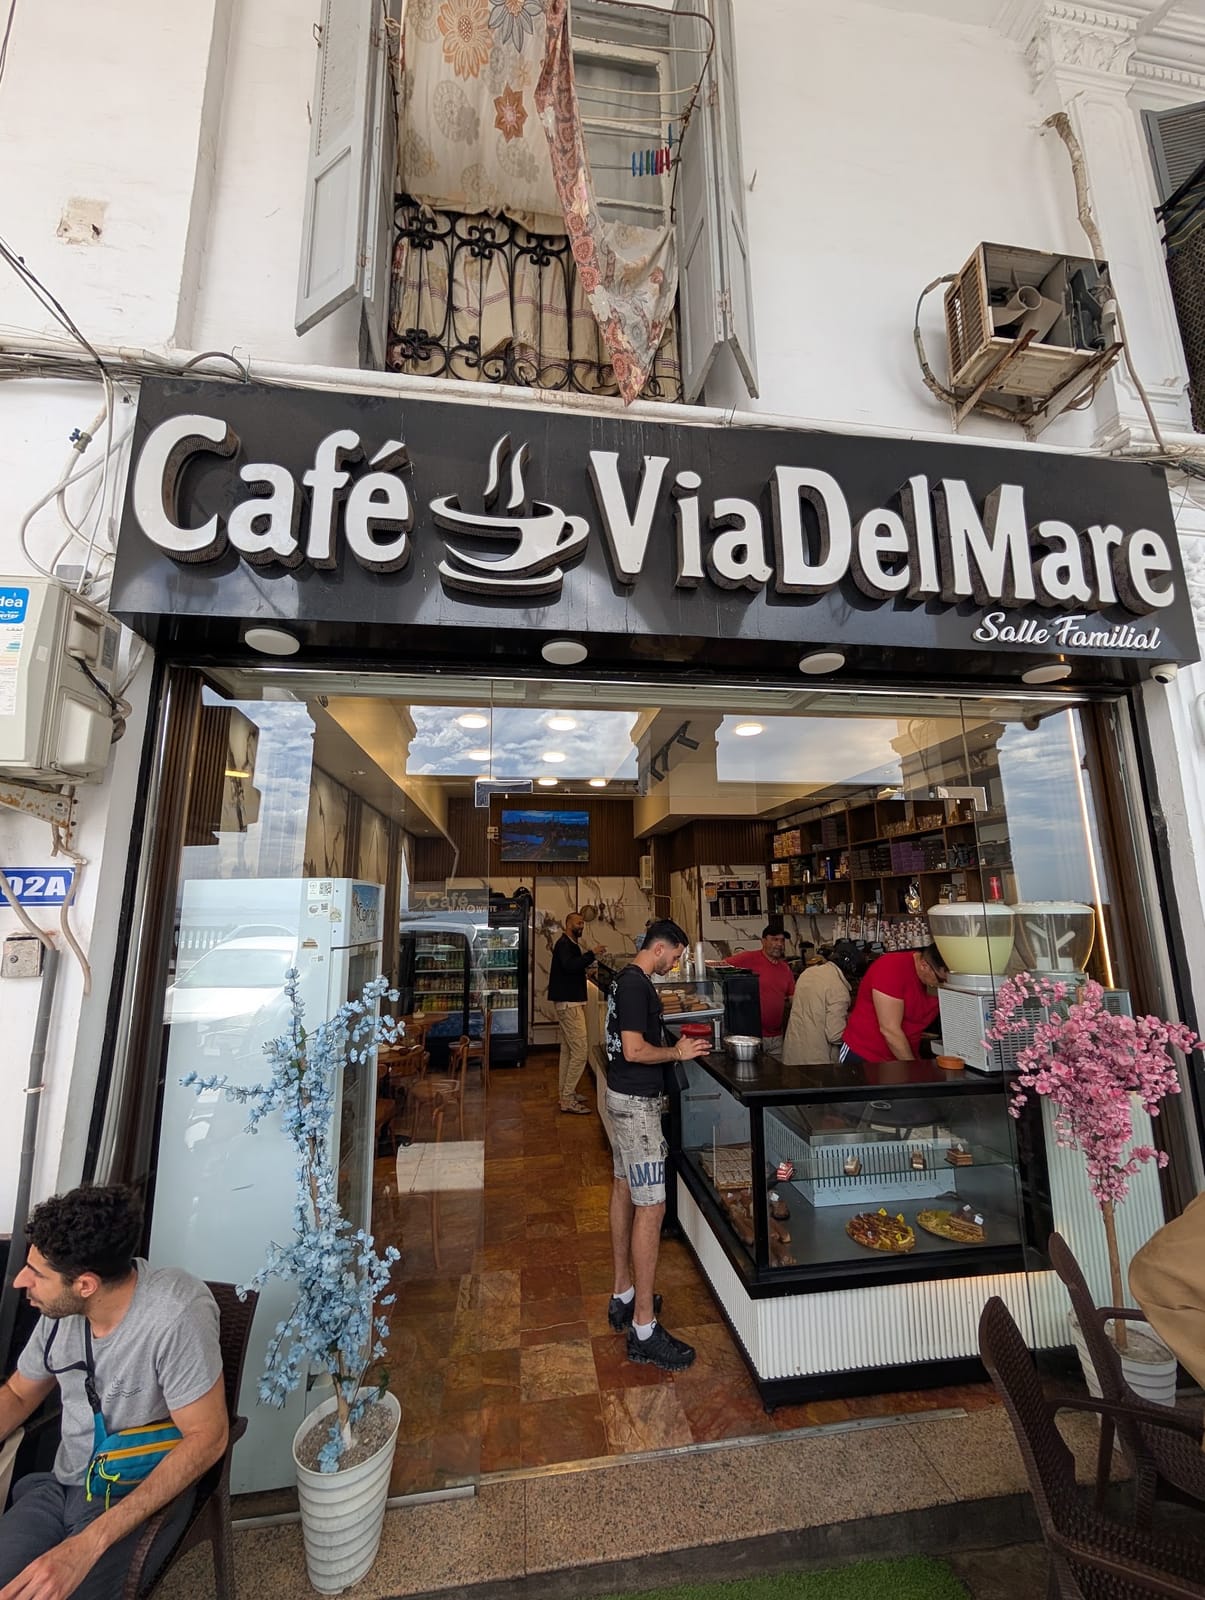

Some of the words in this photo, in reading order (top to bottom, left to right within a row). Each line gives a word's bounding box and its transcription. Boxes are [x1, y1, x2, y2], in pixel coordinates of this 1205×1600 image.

[133, 414, 411, 566] Café
[974, 612, 1050, 643] Salle
[1054, 615, 1161, 649] Familial
